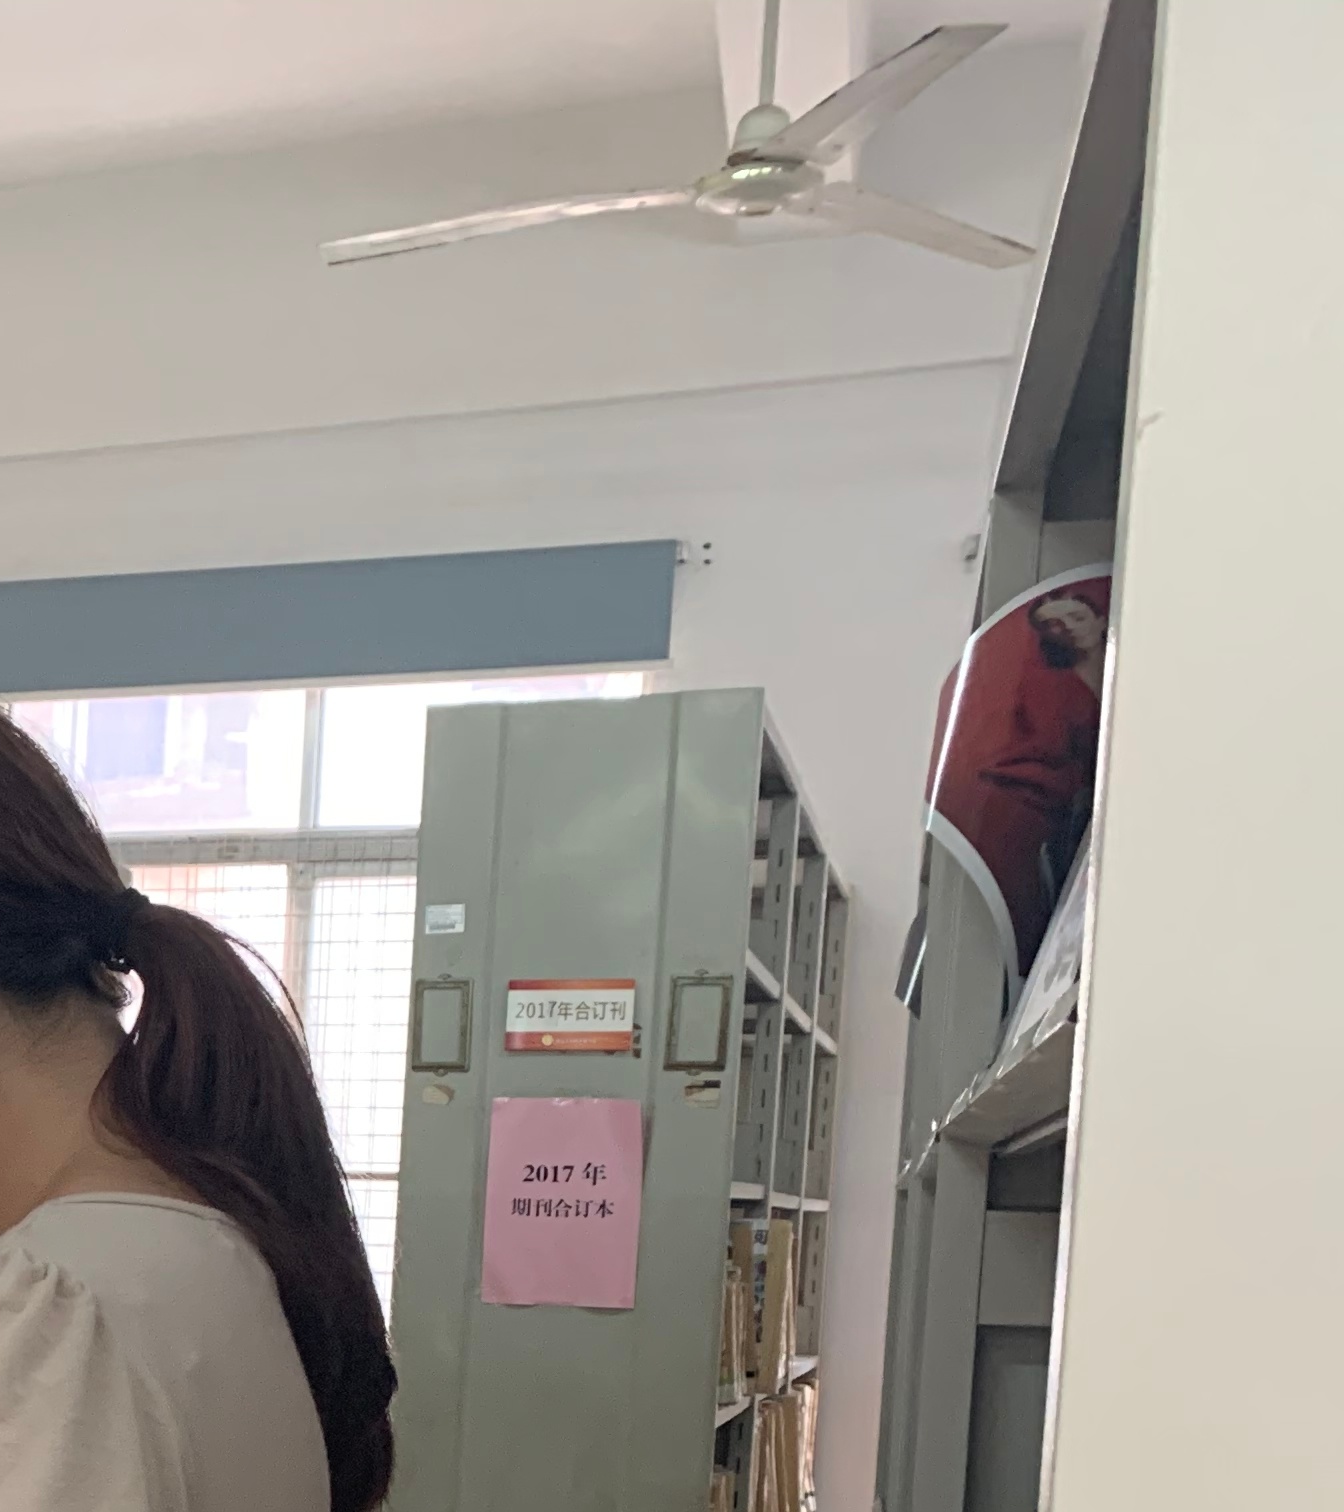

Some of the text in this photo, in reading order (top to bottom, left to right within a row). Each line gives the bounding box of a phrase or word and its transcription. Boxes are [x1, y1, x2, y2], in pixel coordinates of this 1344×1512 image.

[515, 1000, 627, 1022] 2017年合订刊
[522, 1162, 608, 1186] 2017 年
[511, 1197, 615, 1219] 期刊合订本
